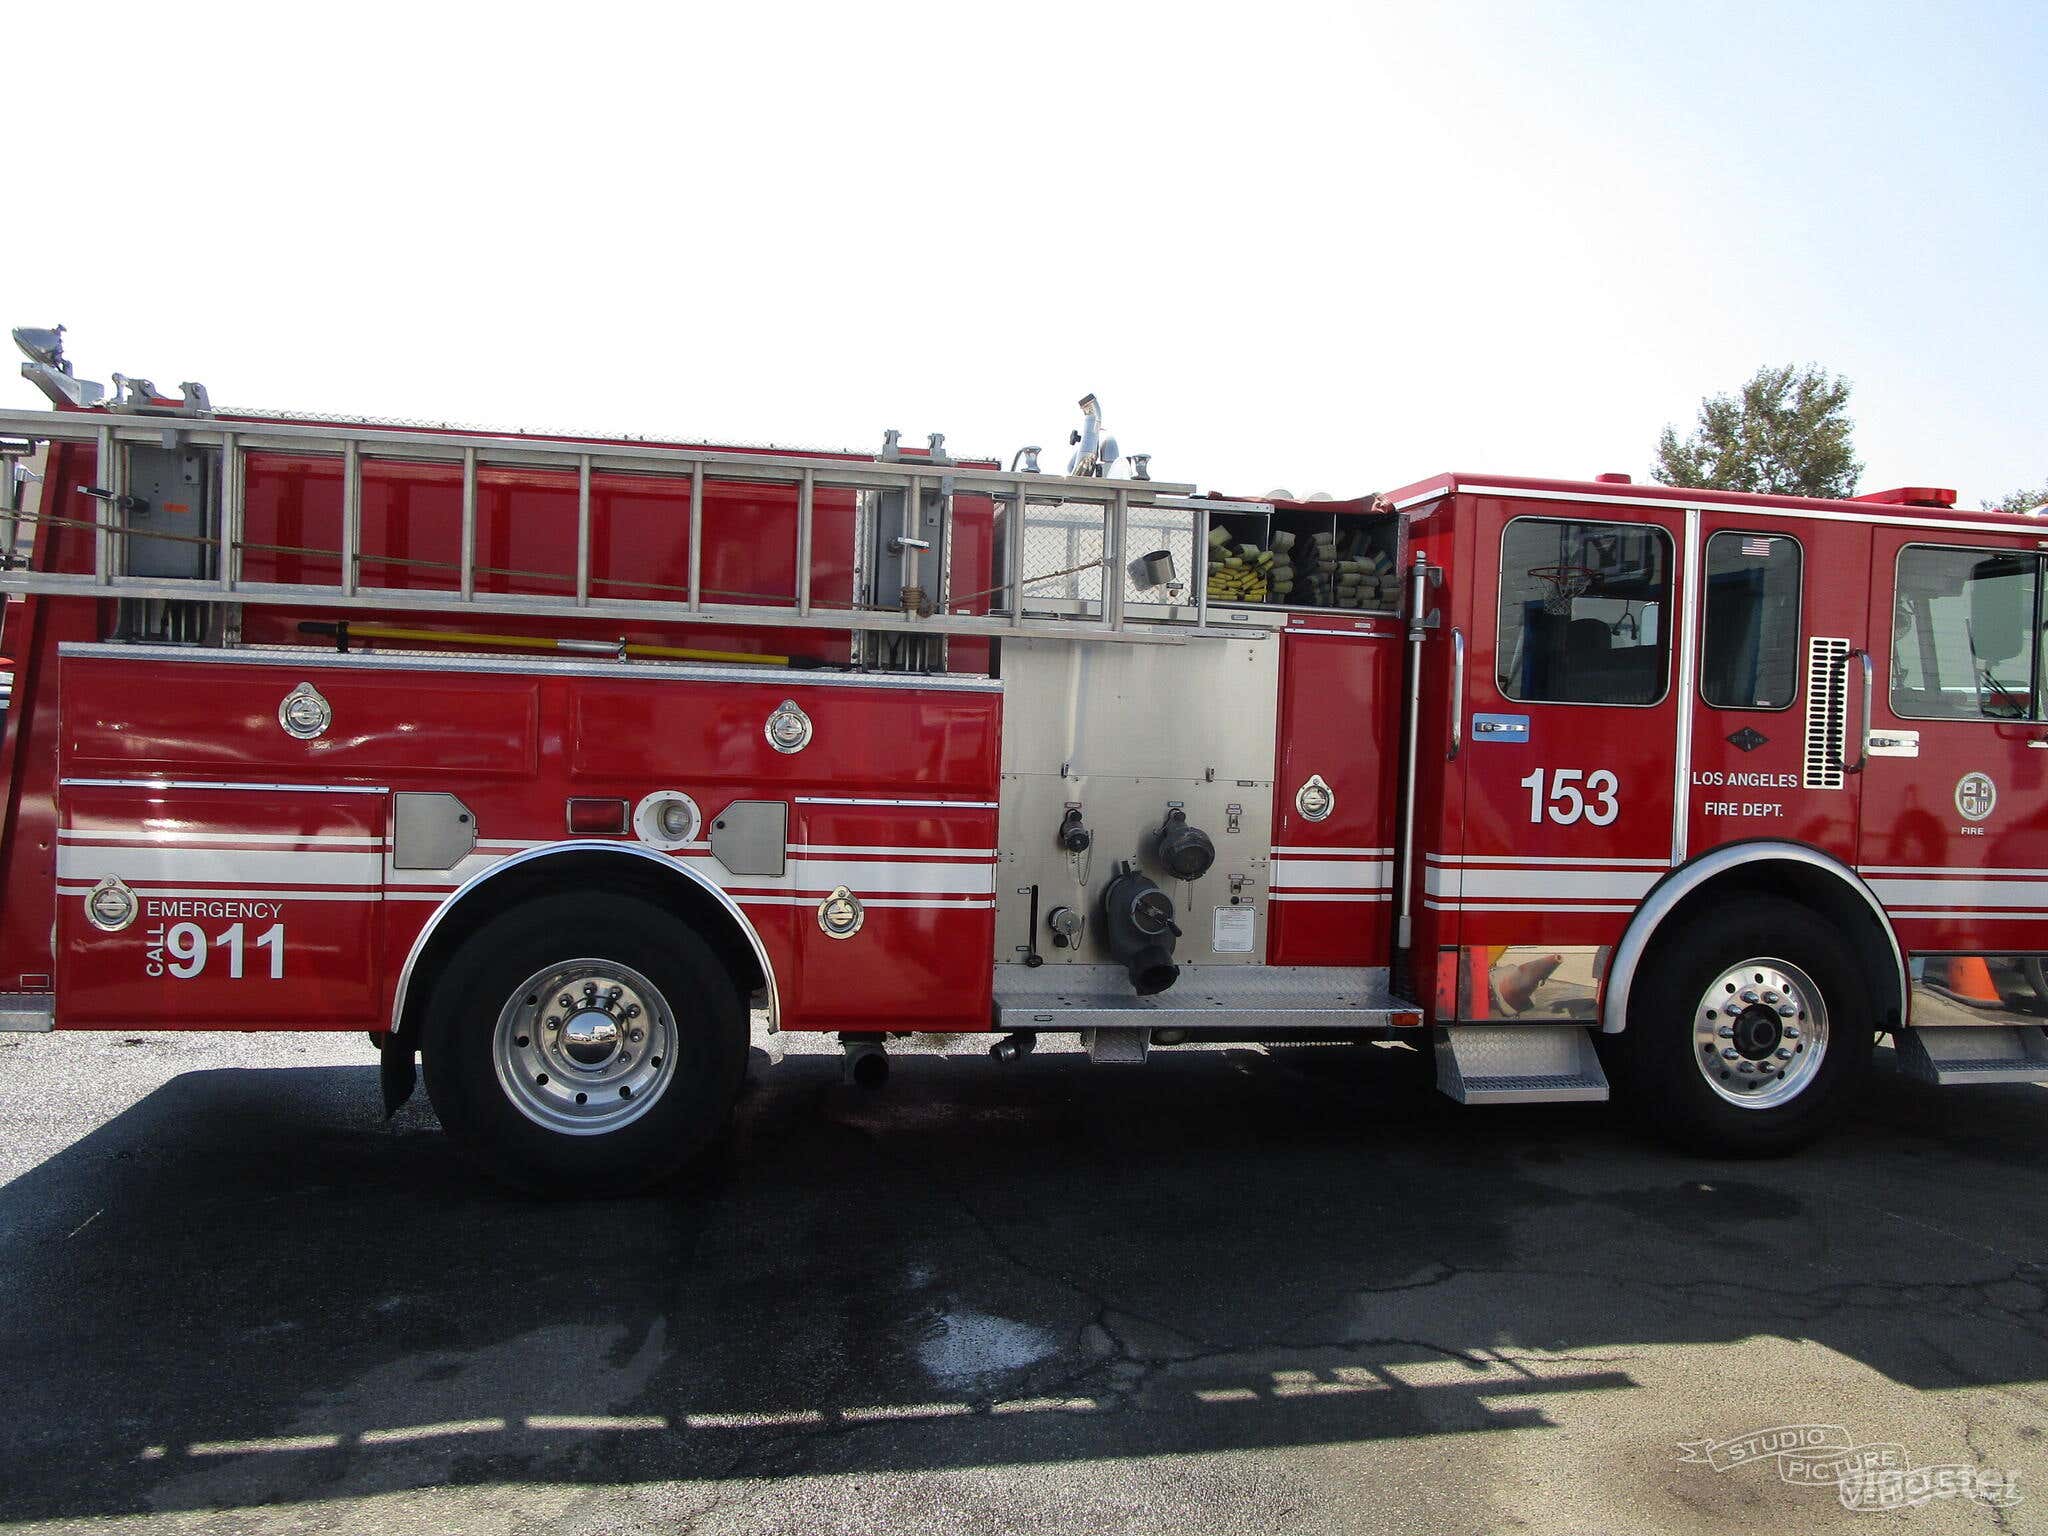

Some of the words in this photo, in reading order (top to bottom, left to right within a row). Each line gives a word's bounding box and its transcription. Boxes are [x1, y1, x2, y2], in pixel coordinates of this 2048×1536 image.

[1692, 771, 1724, 786] LOS
[1727, 773, 1798, 789] ANGELES
[1521, 768, 1620, 827] 153
[1705, 802, 1739, 817] FIRE
[1742, 803, 1784, 818] DEPT.
[1961, 827, 1985, 836] FIRE
[147, 901, 283, 918] EMERGENCY
[146, 923, 165, 978] CALL
[167, 922, 285, 980] 911
